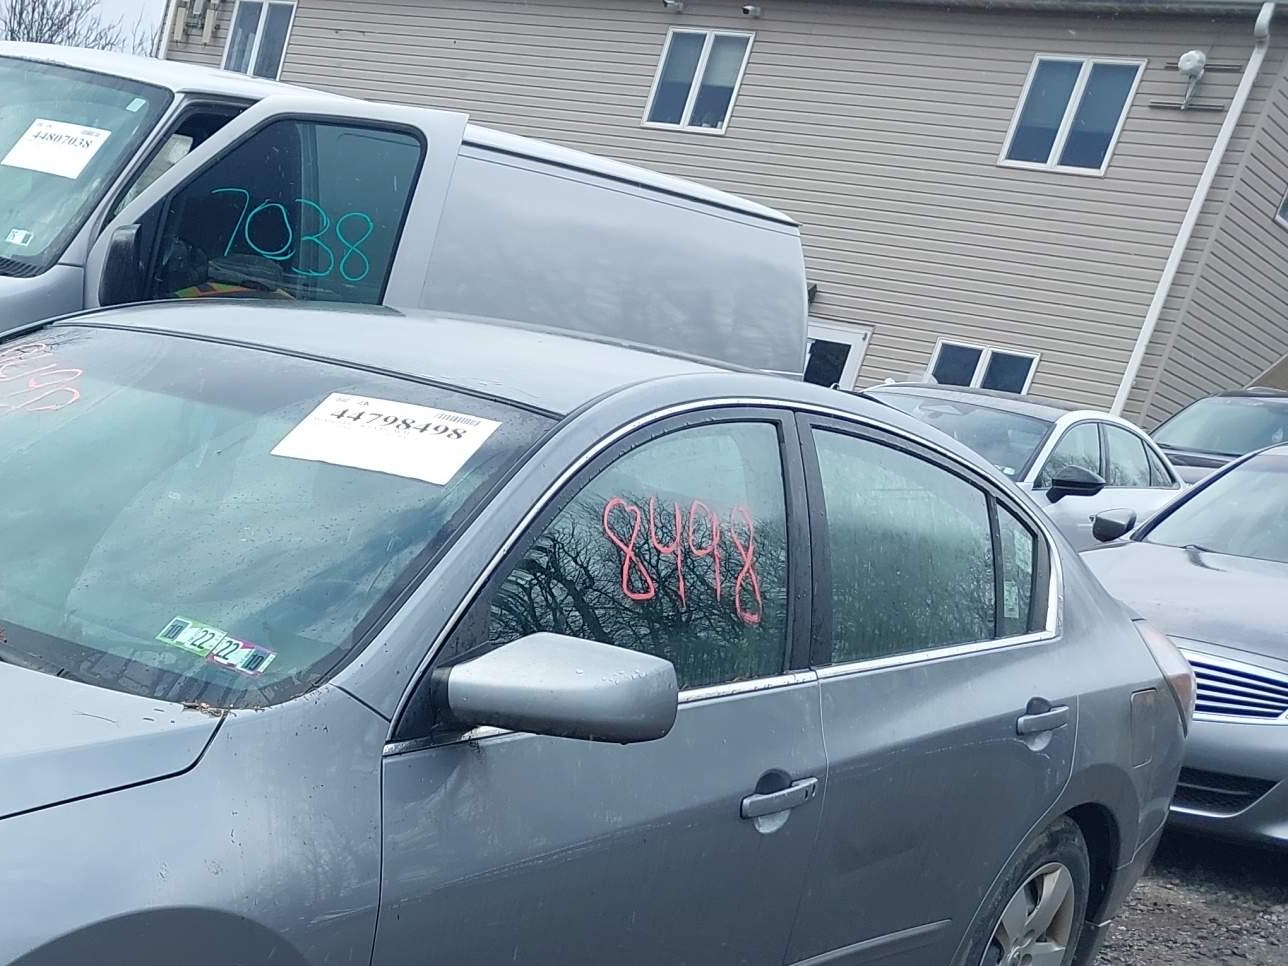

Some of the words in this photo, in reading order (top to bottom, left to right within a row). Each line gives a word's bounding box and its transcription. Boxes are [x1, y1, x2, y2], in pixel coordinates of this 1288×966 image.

[211, 188, 374, 281] 7038
[330, 408, 468, 440] 44798498
[602, 496, 763, 624] 8498
[190, 630, 216, 649] 22
[216, 641, 240, 660] 22
